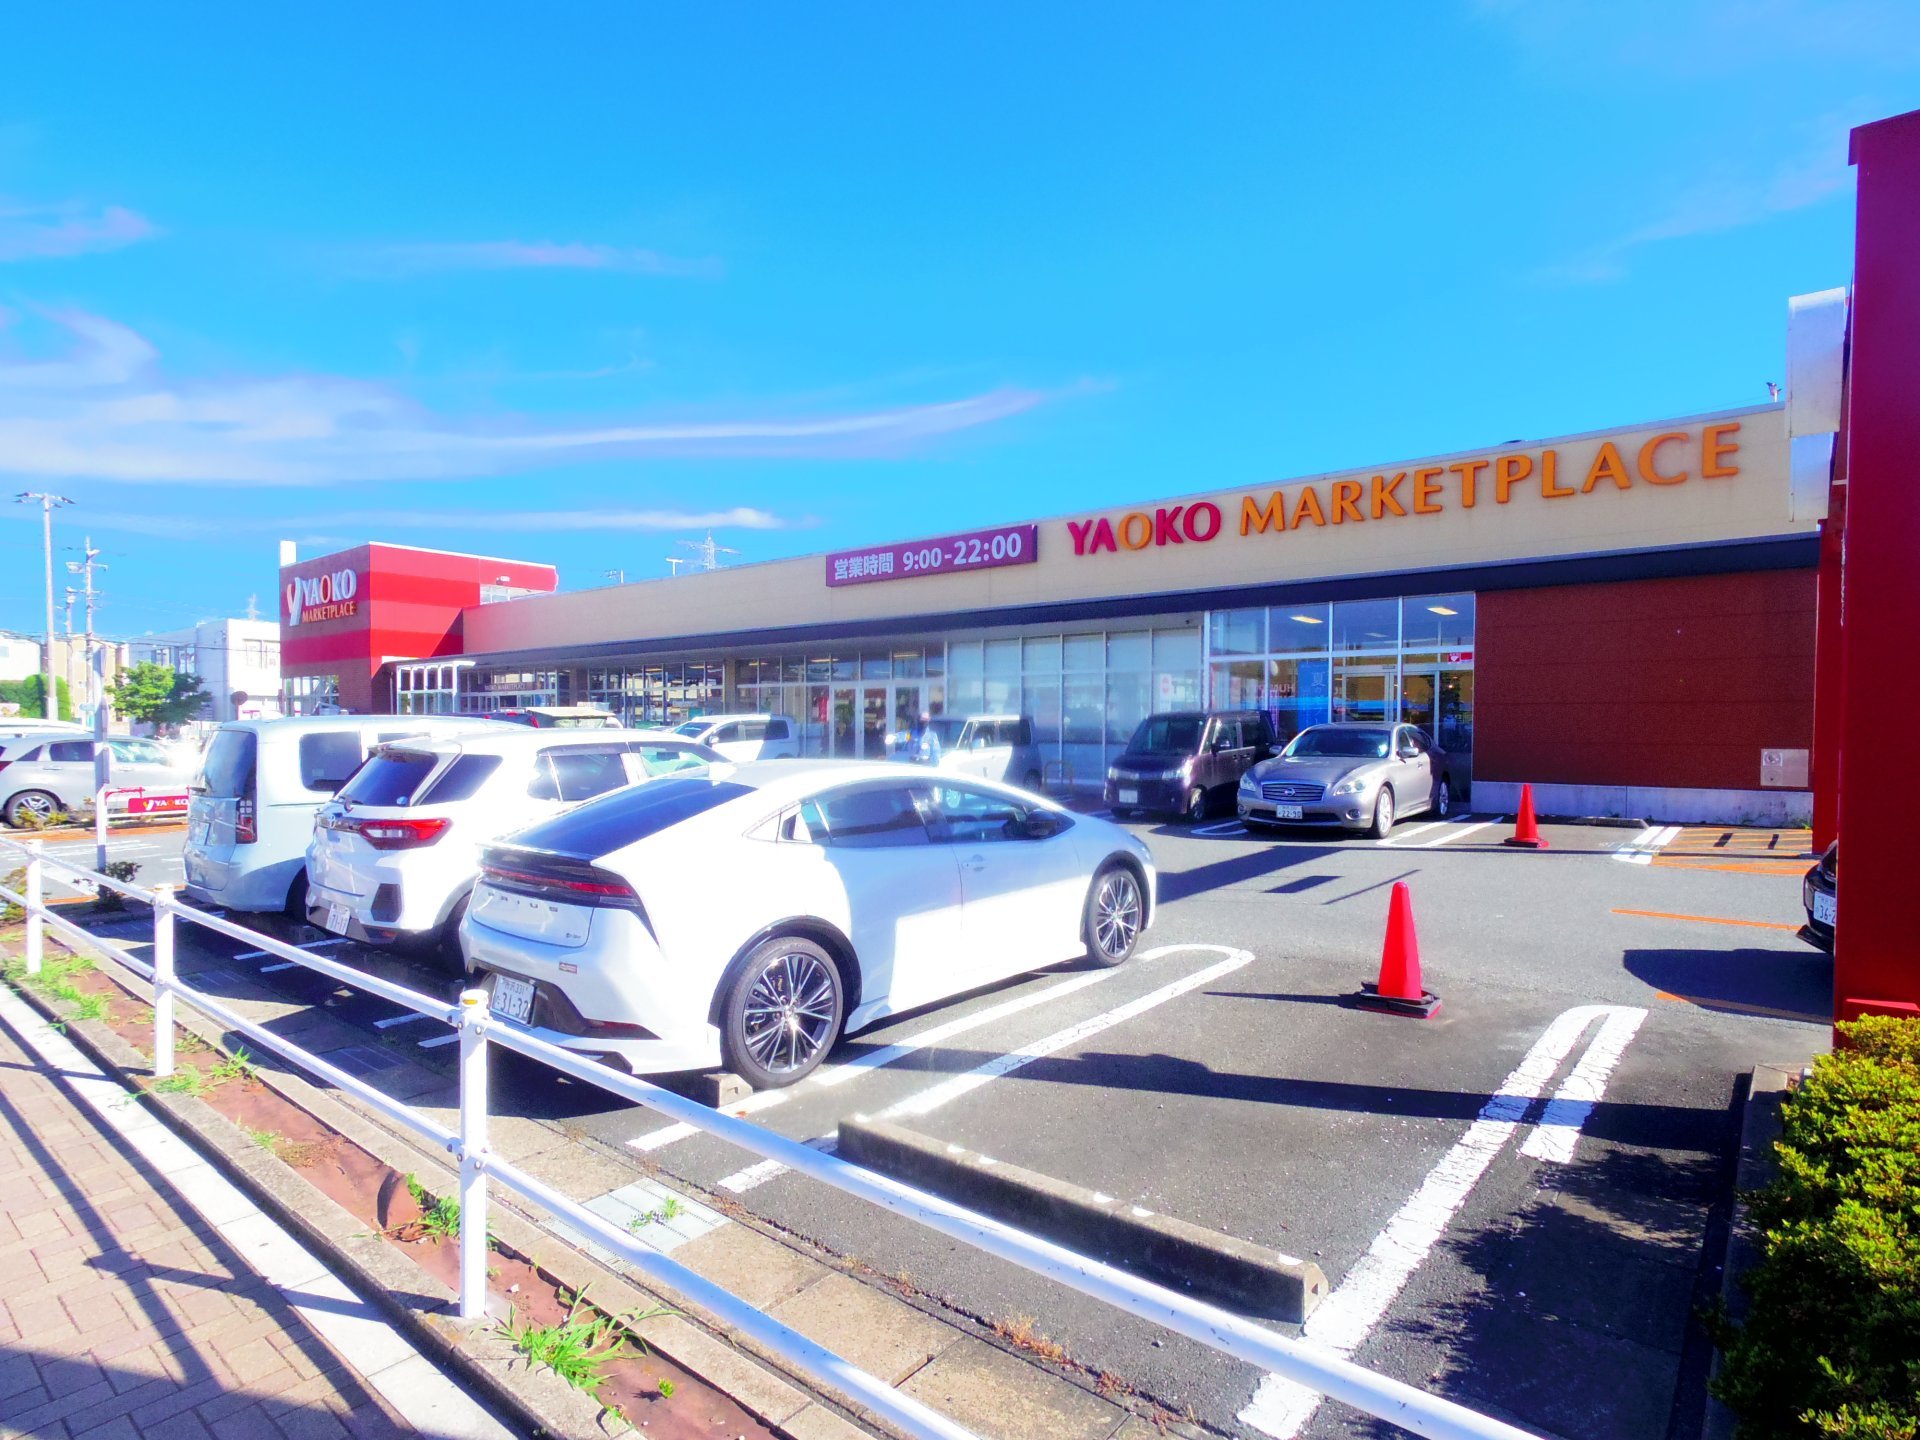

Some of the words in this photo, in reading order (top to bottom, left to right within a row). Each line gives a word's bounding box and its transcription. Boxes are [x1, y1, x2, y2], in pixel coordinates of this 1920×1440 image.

[1067, 502, 1221, 556] YAOKO
[1239, 423, 1741, 537] MARKETPLACE
[834, 552, 894, 580] 営業時間
[903, 533, 1022, 571] 9:00-22:00
[302, 569, 356, 606] YAOKO
[302, 601, 355, 623] MARKETPLACE
[154, 798, 188, 807] YAOKO
